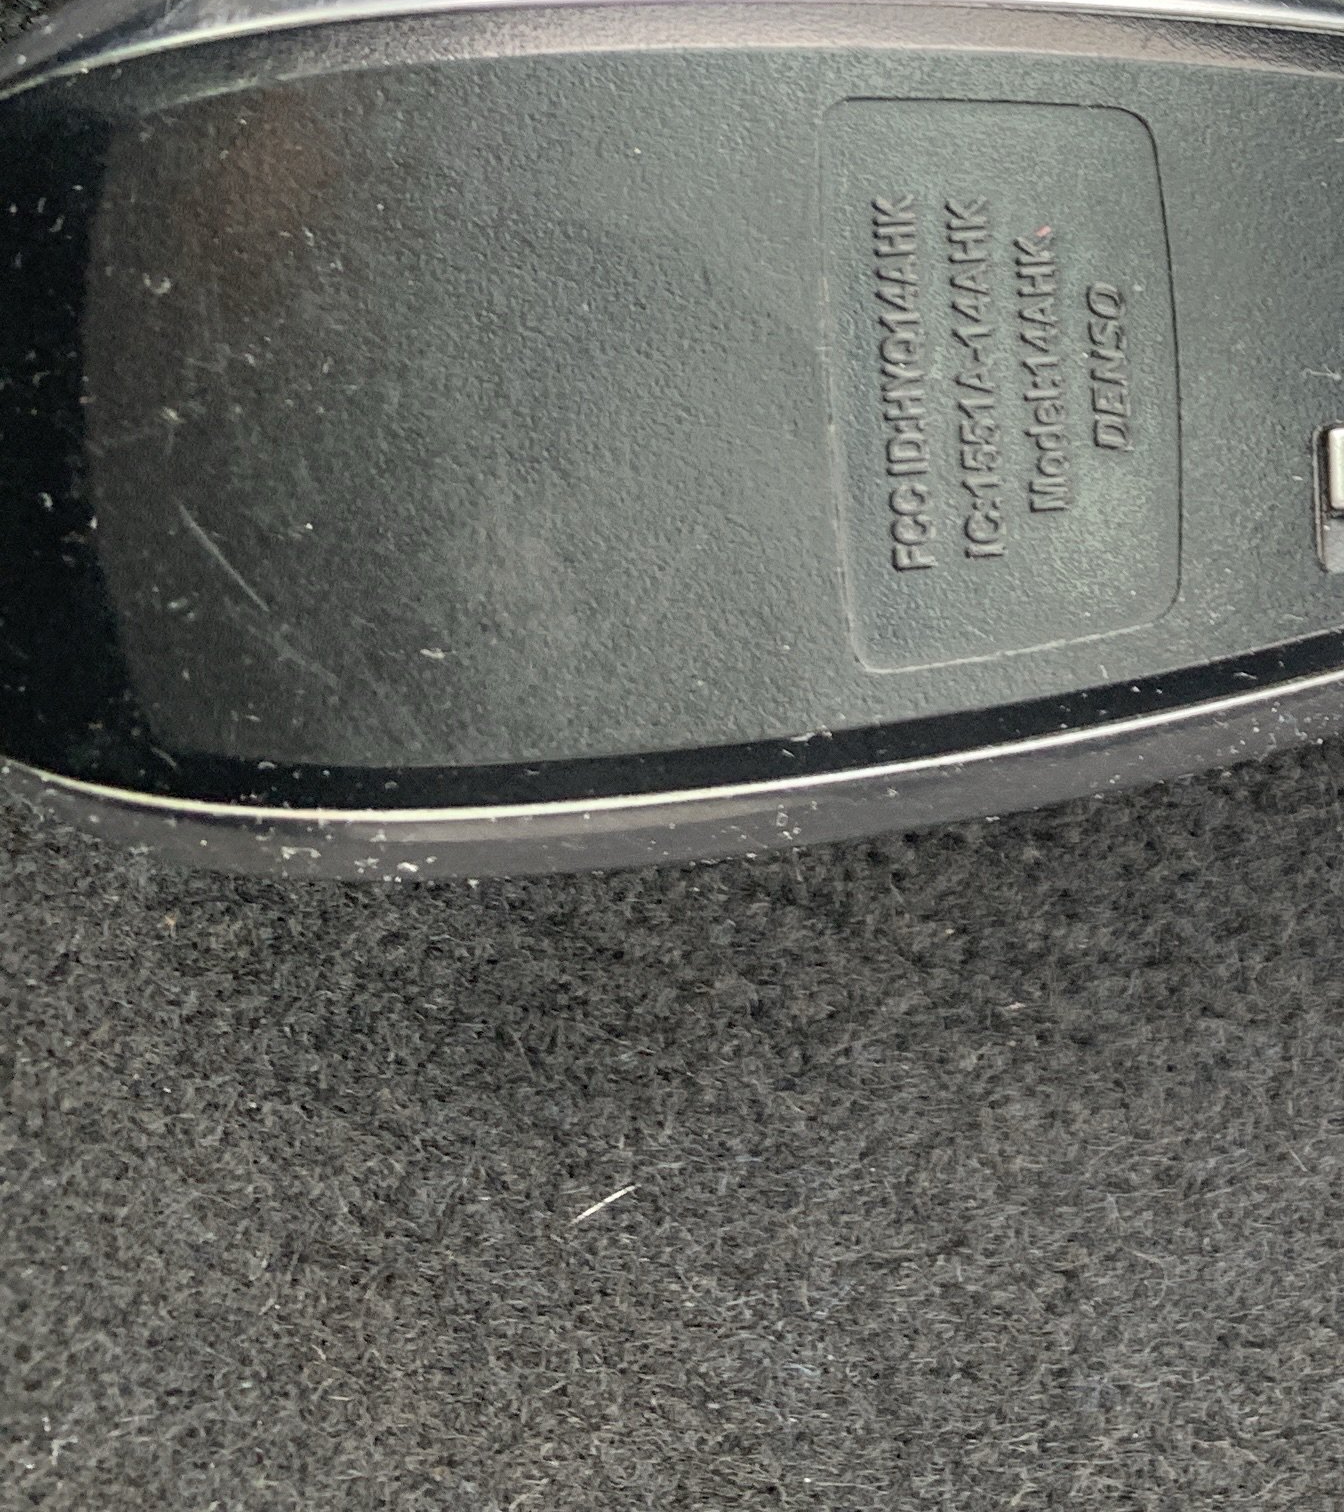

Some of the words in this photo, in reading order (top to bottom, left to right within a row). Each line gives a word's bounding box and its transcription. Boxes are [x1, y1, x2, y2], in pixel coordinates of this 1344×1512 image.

[872, 194, 931, 477] ID:HYQ14AHK
[945, 194, 1005, 561] IC:1551A-14AHK
[1014, 234, 1070, 514] Model:14AHK
[1086, 281, 1134, 453] DENSO
[892, 488, 936, 573] FCC
